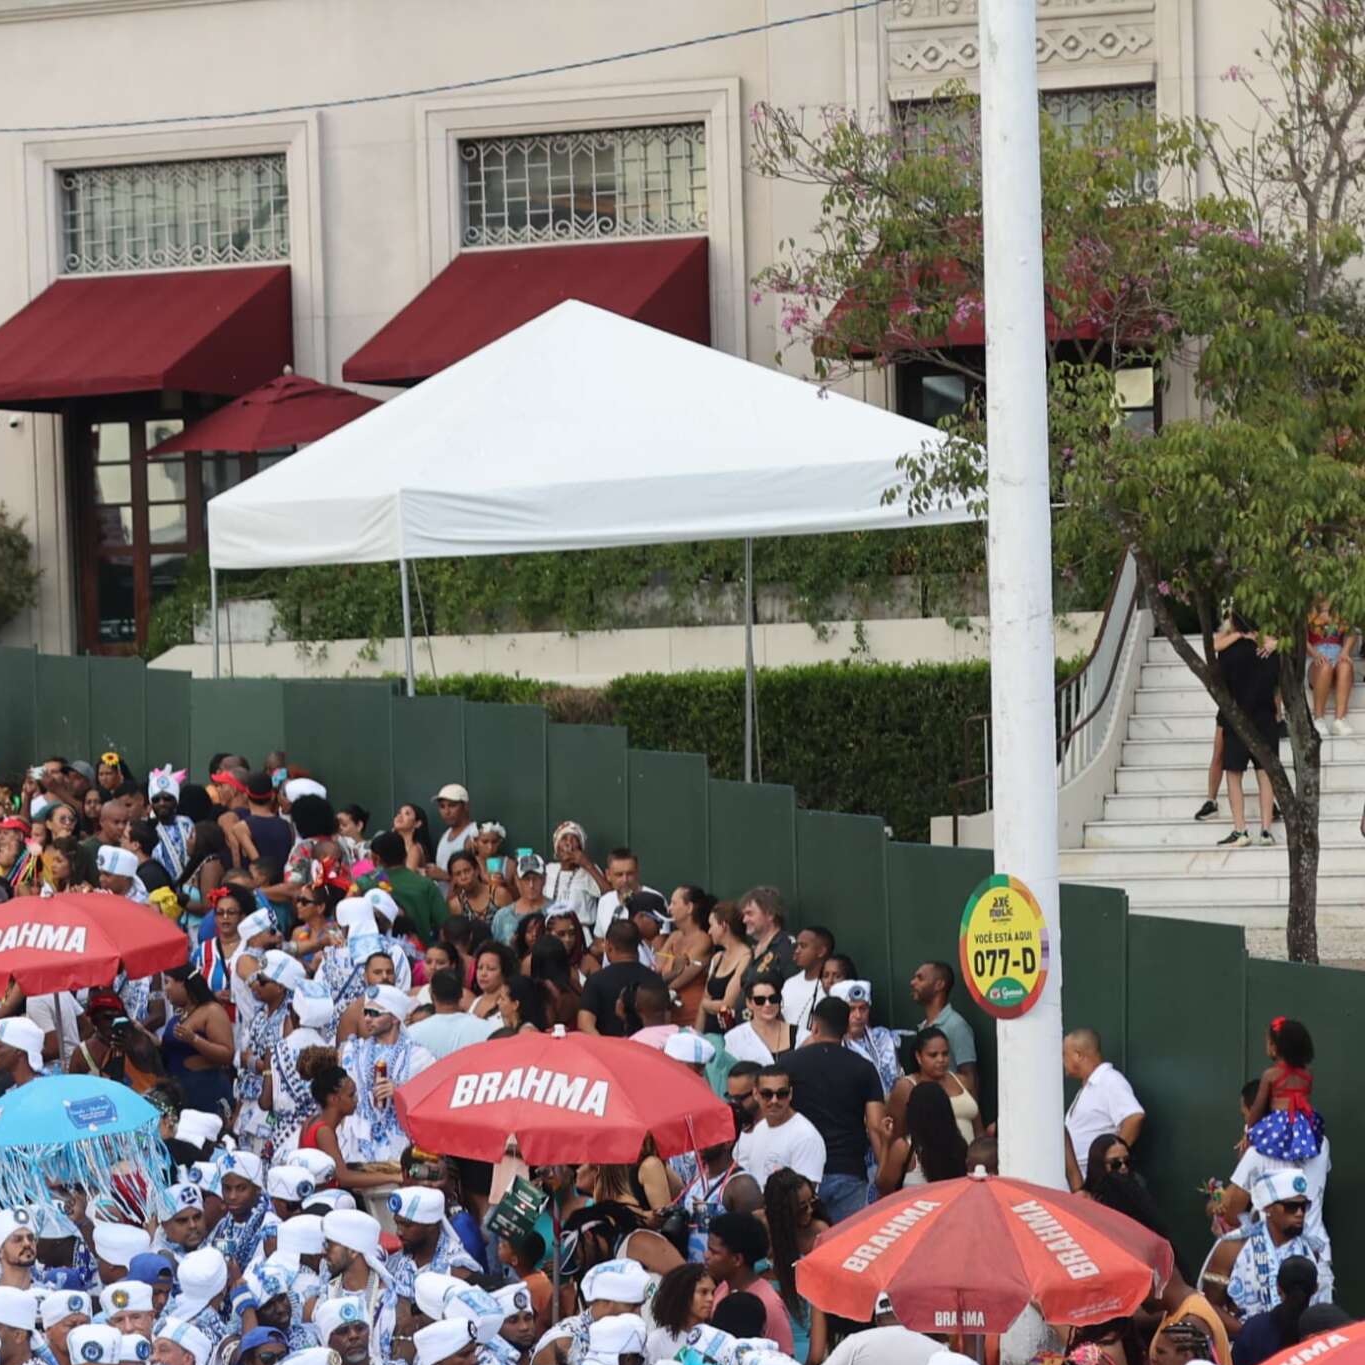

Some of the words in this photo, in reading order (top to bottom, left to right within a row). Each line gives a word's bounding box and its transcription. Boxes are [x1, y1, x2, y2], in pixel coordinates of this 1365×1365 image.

[974, 932, 992, 945] VOCÊ
[994, 930, 1013, 943] ESTÁ
[1014, 930, 1032, 942] AQUI
[974, 947, 1036, 977] 077-D
[449, 1065, 610, 1119] BRAHMA
[842, 1200, 942, 1273] BRAHMA
[1011, 1200, 1101, 1280] BRAHMA
